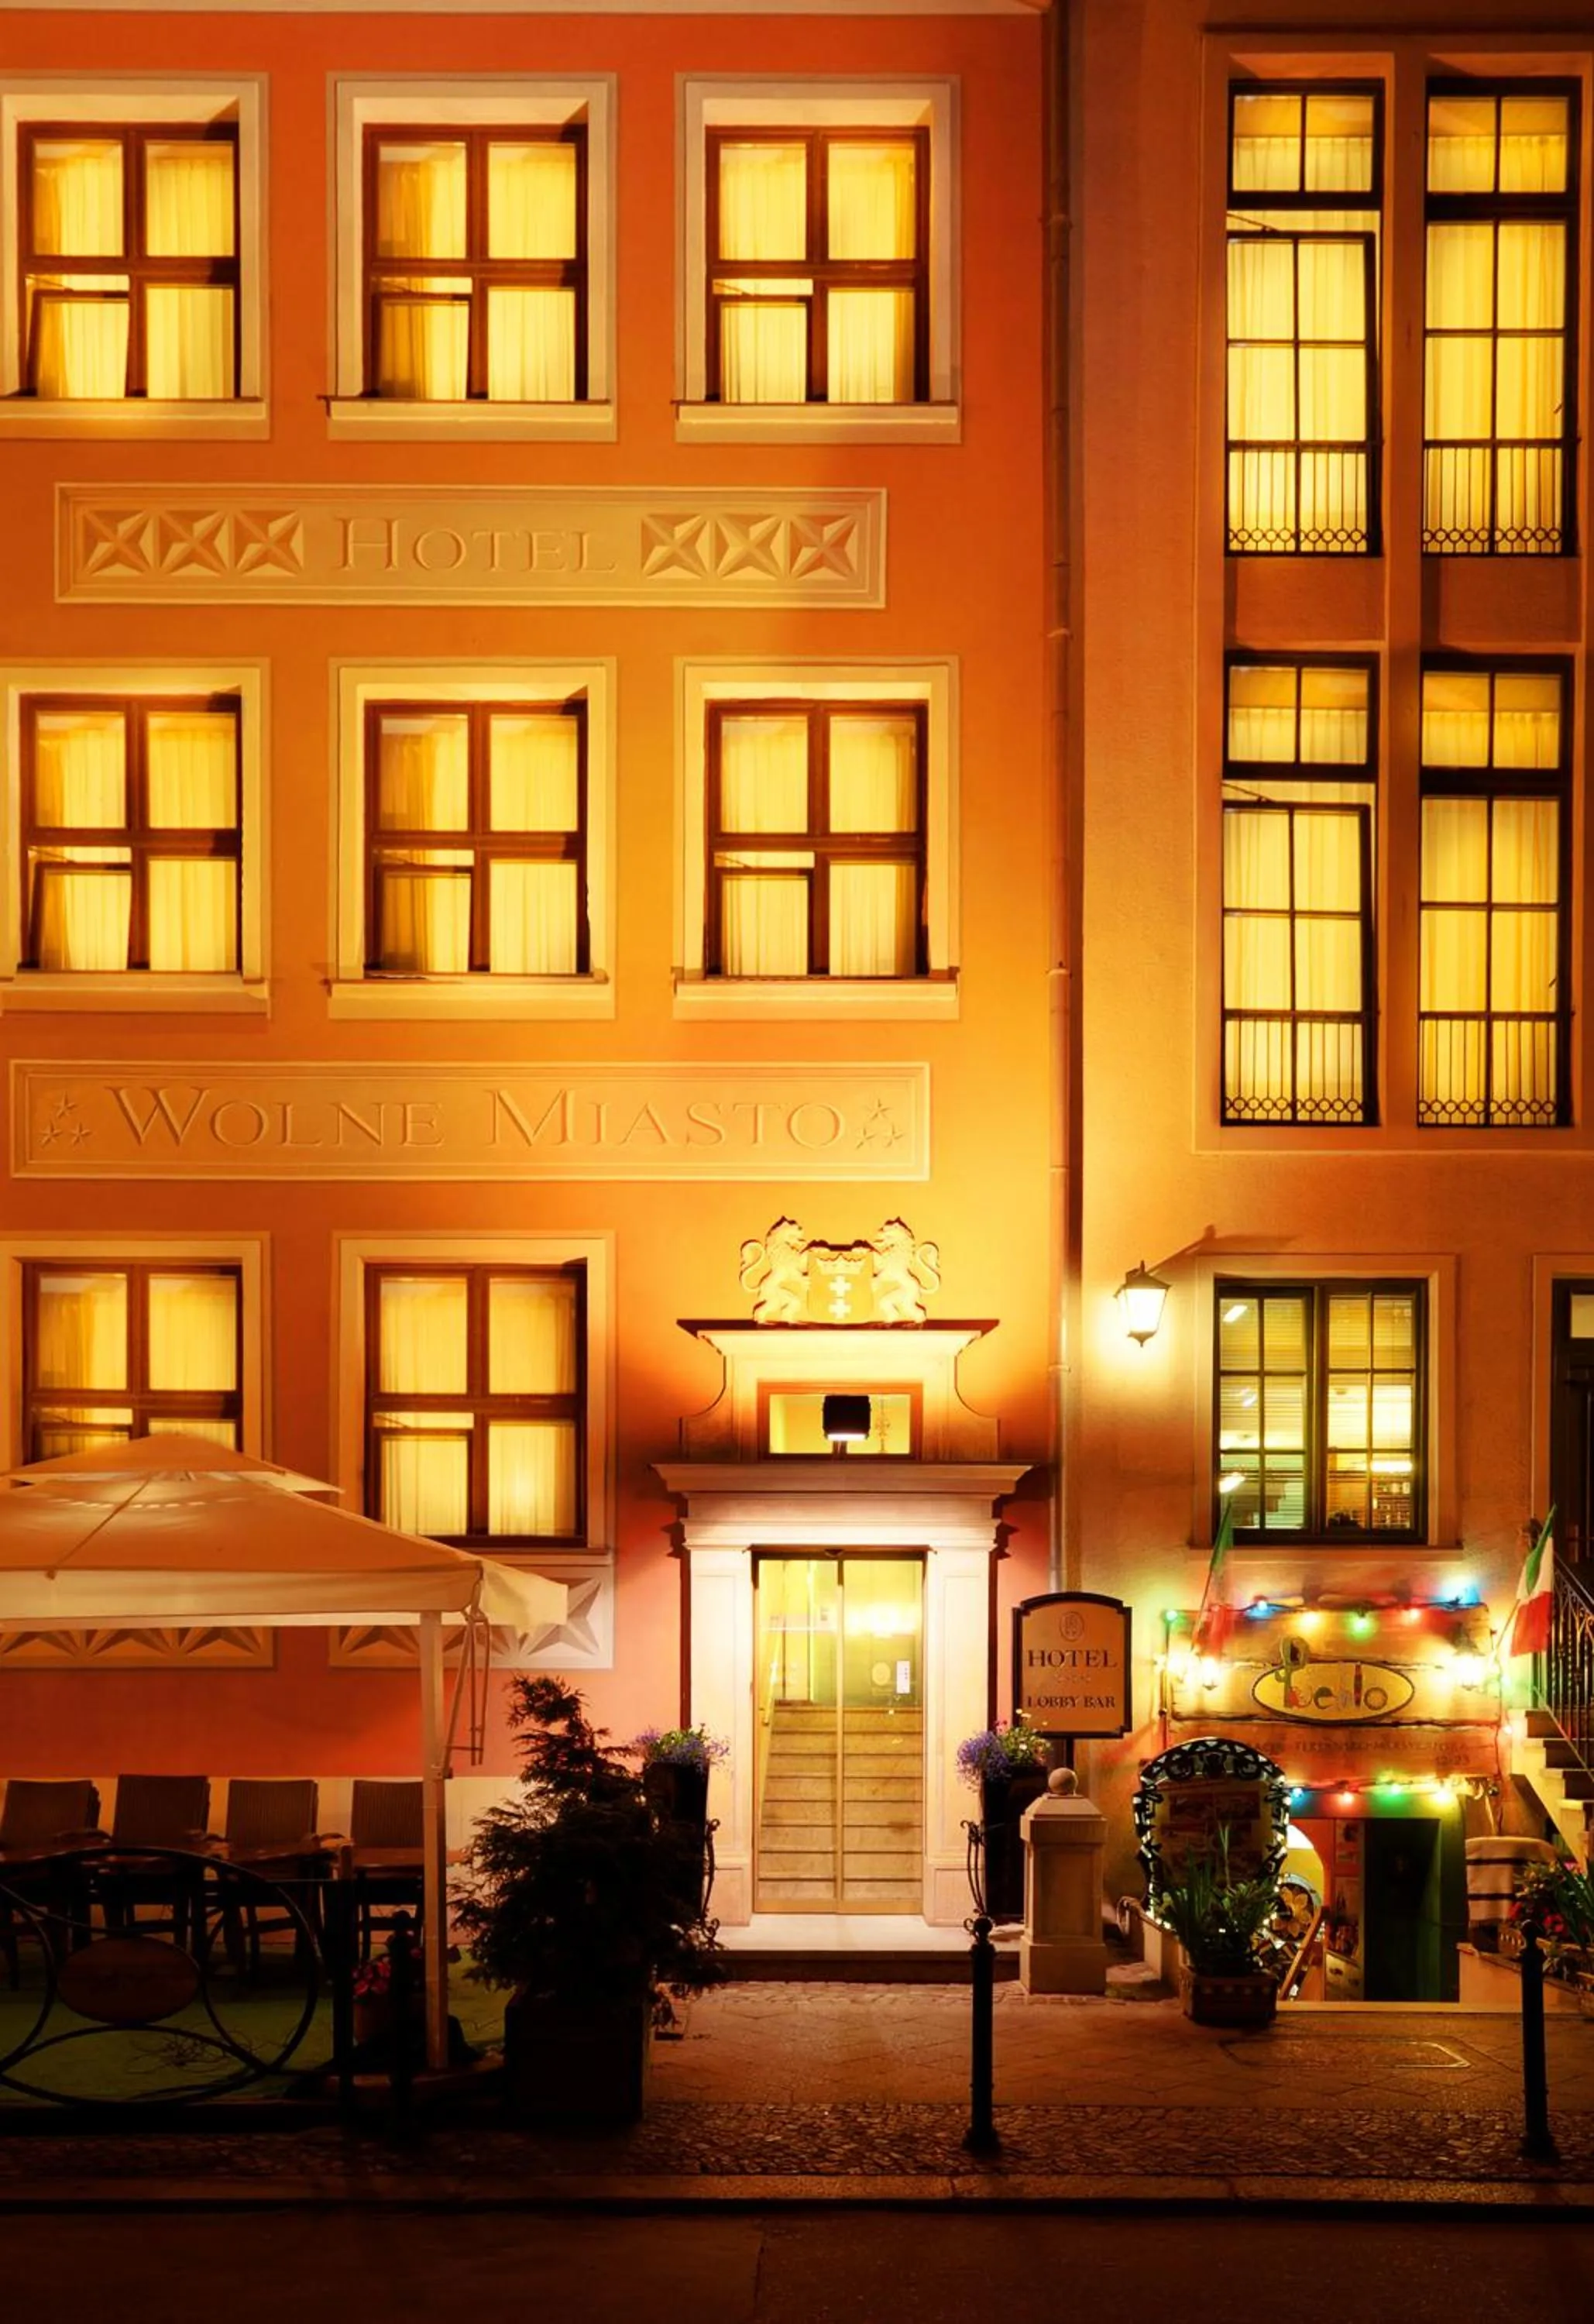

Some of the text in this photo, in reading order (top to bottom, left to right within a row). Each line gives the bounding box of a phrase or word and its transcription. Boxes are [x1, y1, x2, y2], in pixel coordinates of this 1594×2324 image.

[335, 517, 617, 572] HOTEL
[106, 1086, 845, 1150] WOLNE MIASTO
[1028, 1649, 1118, 1668] HOTEL
[1027, 1696, 1115, 1708] LOBBY BAR
